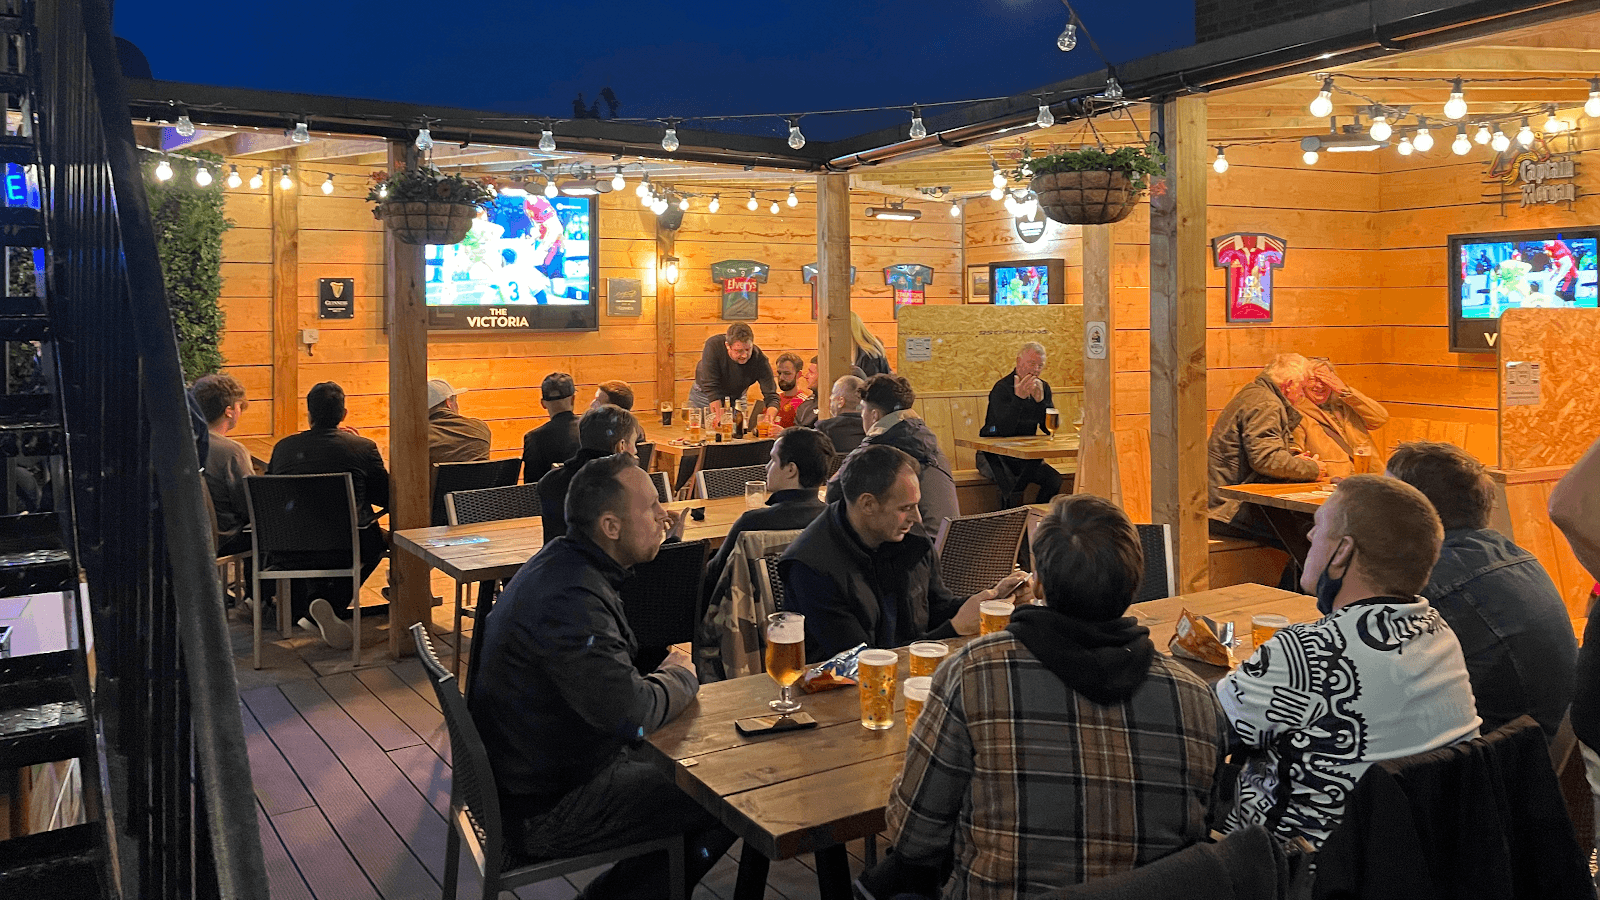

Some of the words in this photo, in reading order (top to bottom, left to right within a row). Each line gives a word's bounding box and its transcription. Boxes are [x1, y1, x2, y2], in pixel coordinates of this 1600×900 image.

[1520, 156, 1574, 183] Captain
[1519, 184, 1575, 208] Morgan
[508, 281, 519, 301] 3
[727, 279, 757, 291] Elverys
[489, 308, 508, 316] THE
[467, 316, 530, 328] VICTORIA
